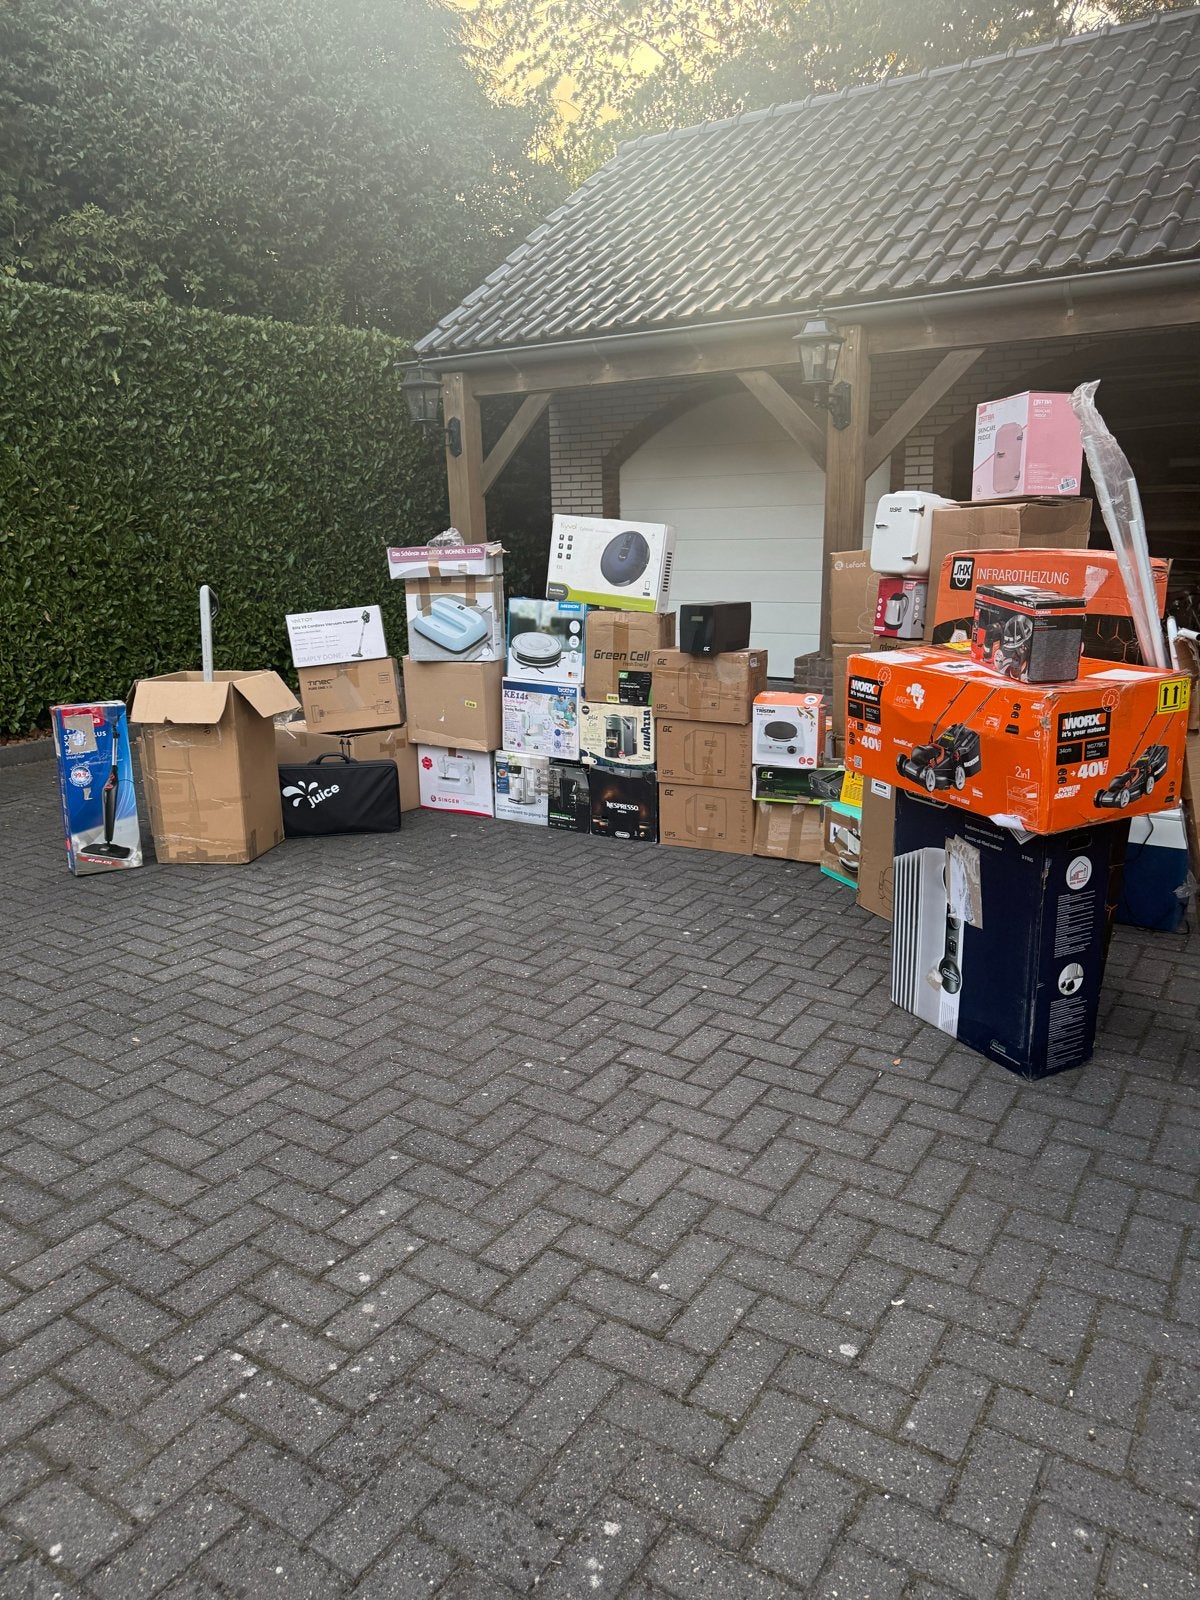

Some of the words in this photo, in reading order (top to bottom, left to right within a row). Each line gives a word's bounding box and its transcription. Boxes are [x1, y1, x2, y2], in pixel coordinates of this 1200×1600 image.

[976, 568, 1070, 585] INFRAROTHEIZUNG
[297, 655, 321, 664] SIMPLY
[593, 649, 627, 661] Green
[630, 650, 650, 662] Cell
[851, 680, 875, 694] WORX
[504, 690, 529, 700] KE14s
[1063, 714, 1100, 730] WORX
[640, 710, 651, 752] LAVAZZA
[1073, 729, 1086, 737] your
[1087, 726, 1106, 734] nature
[761, 771, 774, 779] GC
[1015, 765, 1030, 780] 2in1
[307, 784, 340, 809] juice
[606, 800, 639, 811] NESPRESSO
